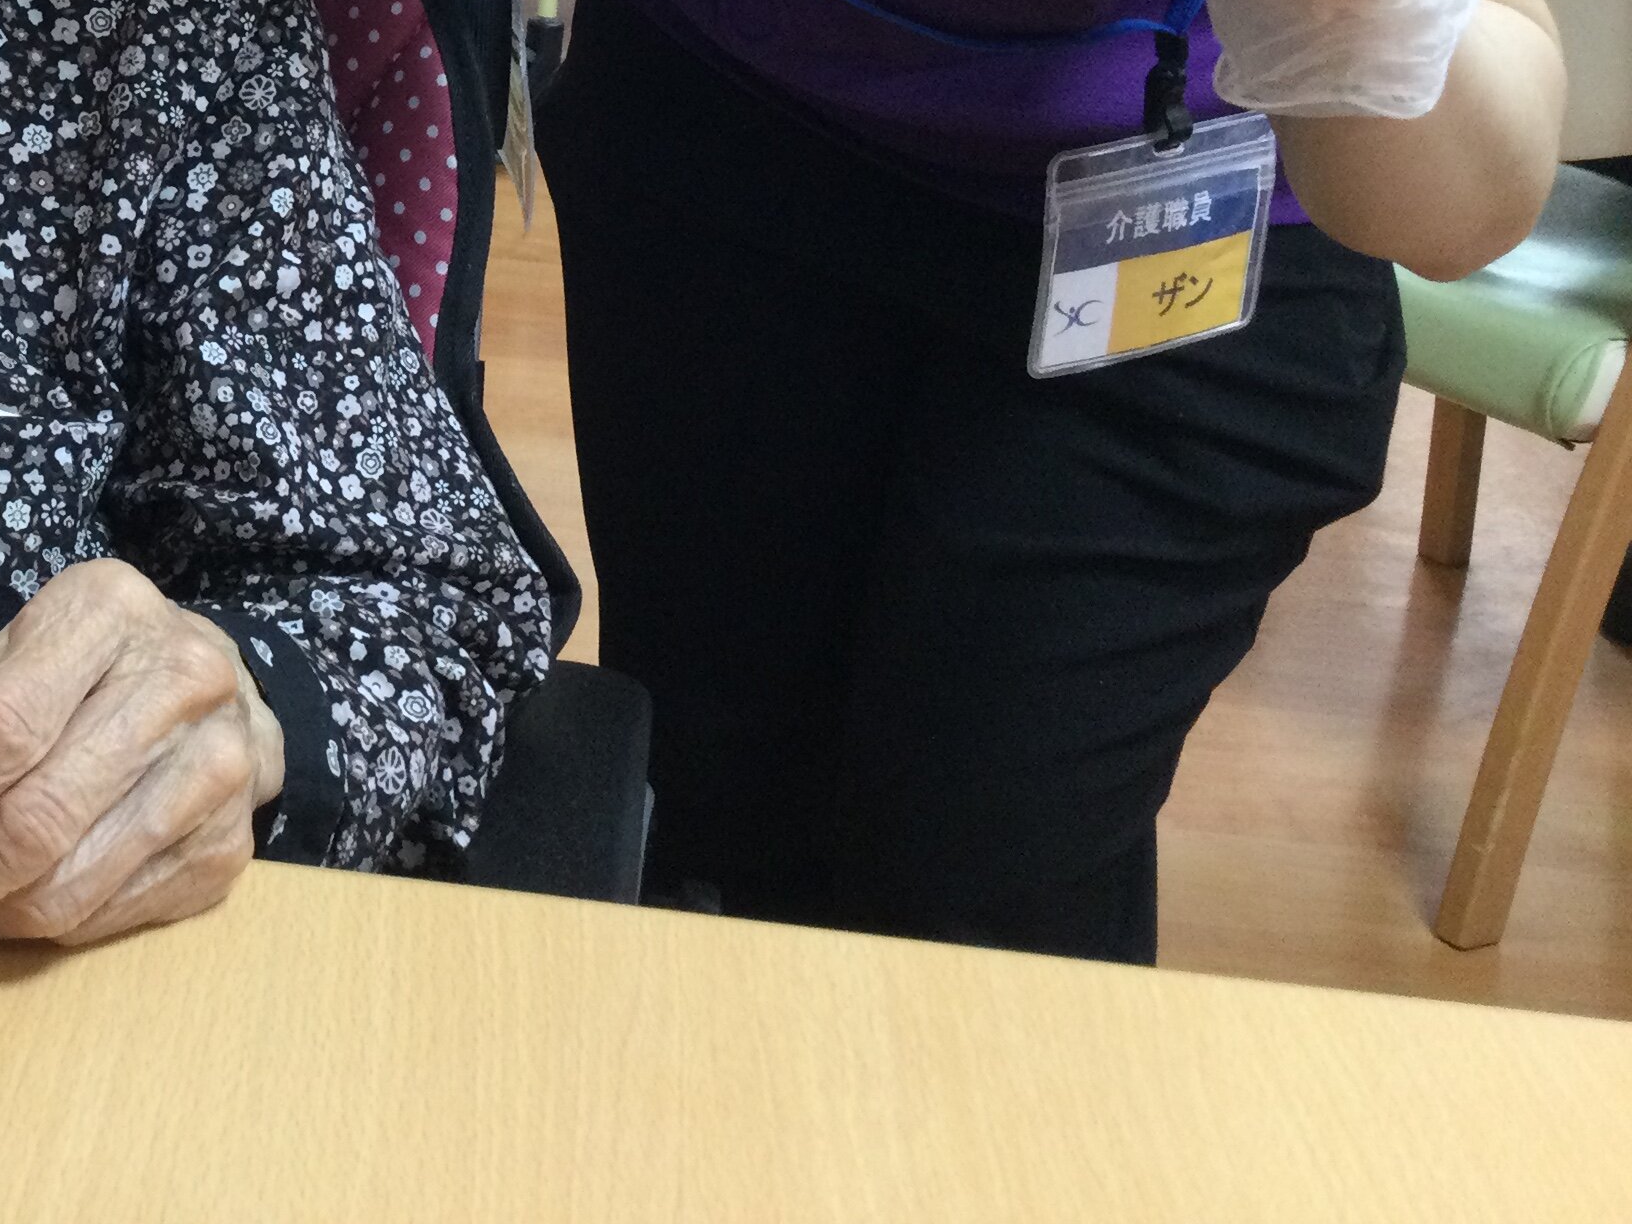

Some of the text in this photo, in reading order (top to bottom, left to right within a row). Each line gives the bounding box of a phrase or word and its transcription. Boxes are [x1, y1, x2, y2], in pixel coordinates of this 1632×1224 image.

[1105, 189, 1213, 245] 介護職員
[1151, 271, 1214, 317] ザン
